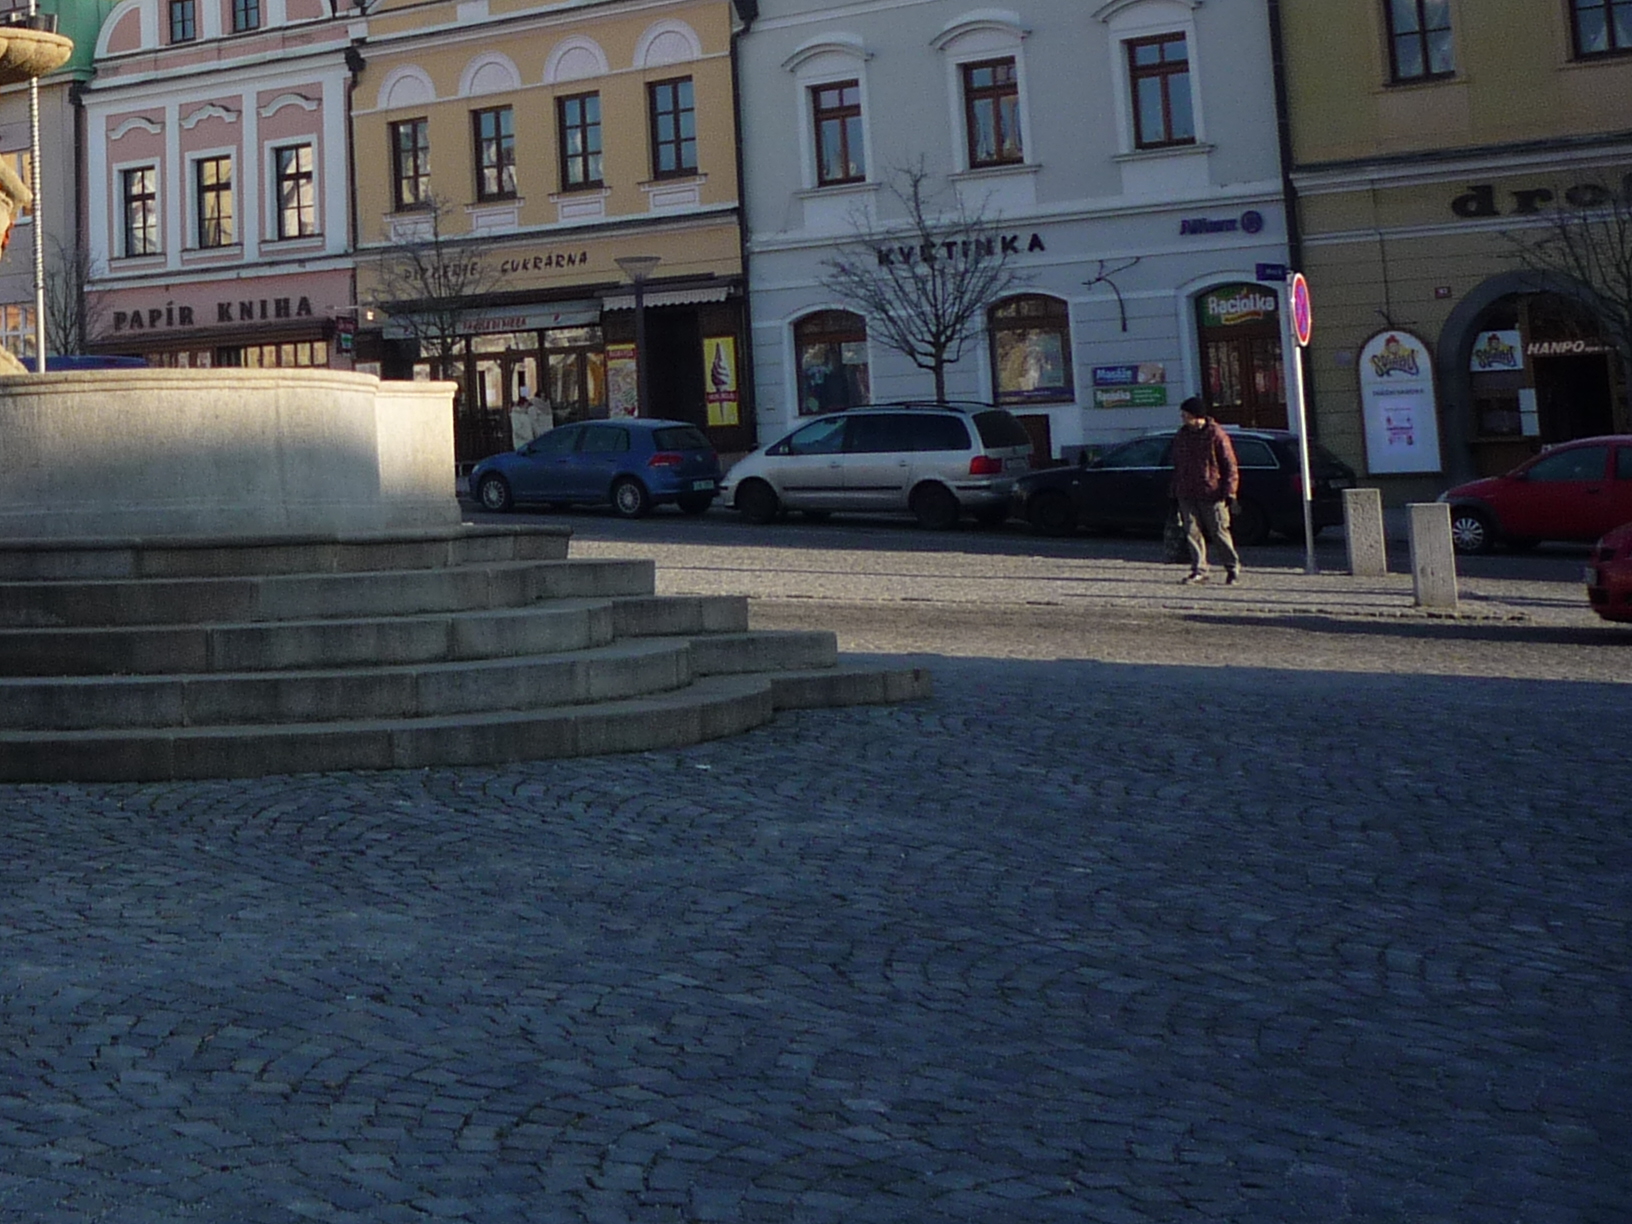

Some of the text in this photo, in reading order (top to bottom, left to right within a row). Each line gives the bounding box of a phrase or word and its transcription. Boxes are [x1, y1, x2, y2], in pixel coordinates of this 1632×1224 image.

[1451, 172, 1632, 218] dro
[113, 296, 313, 330] PAPÍR KNIHA
[1527, 340, 1585, 355] HANPO
